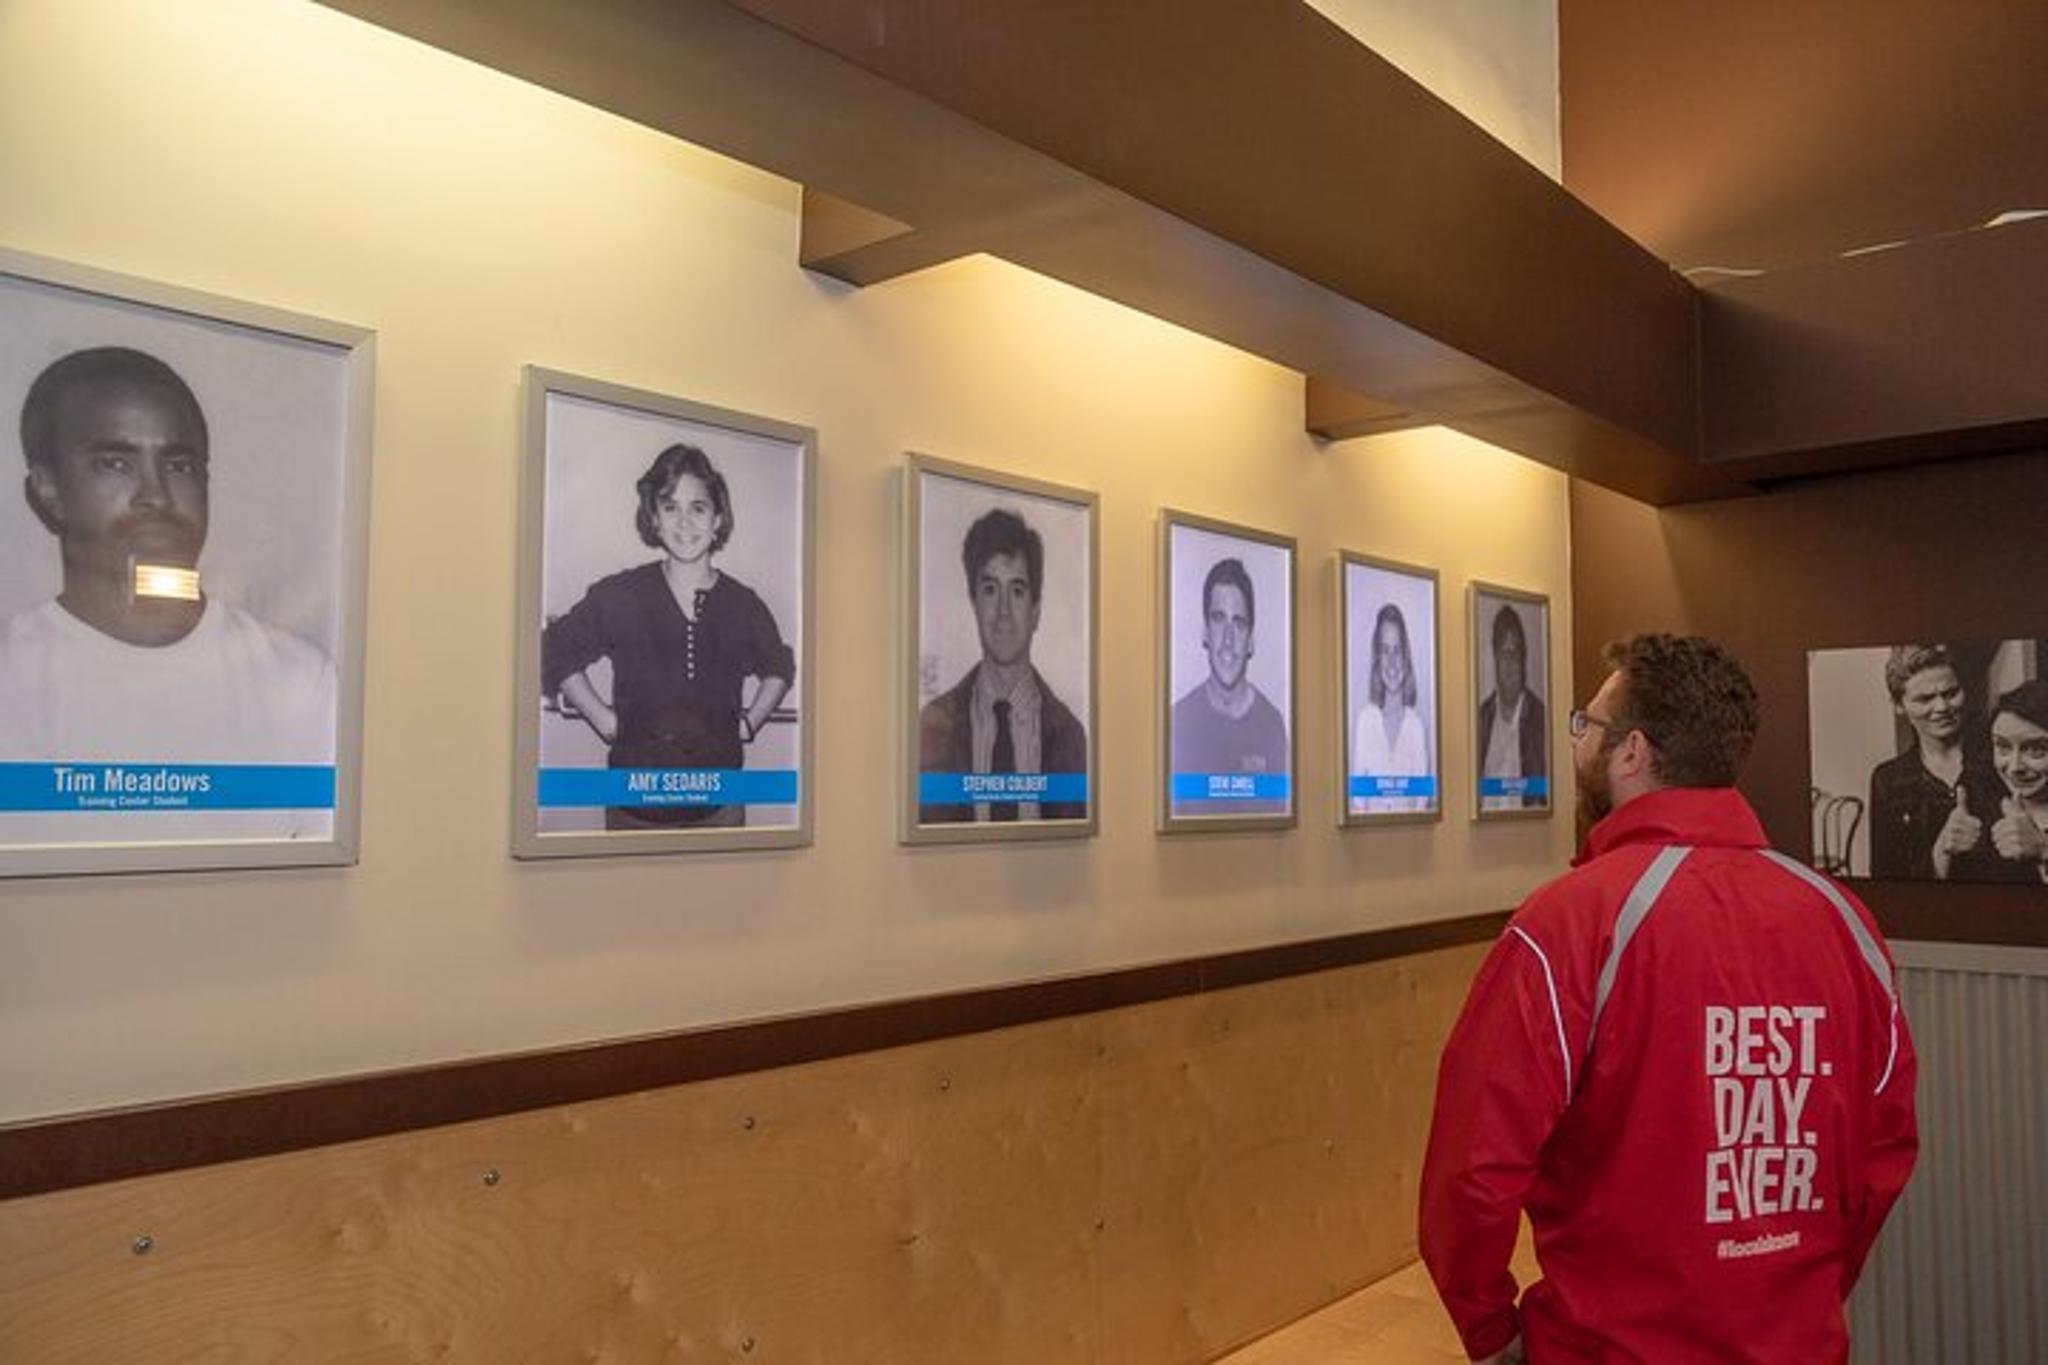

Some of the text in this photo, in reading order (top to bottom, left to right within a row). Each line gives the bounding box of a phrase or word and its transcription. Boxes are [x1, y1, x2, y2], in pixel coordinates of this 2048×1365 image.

[54, 767, 211, 792] Tim Meadows
[628, 773, 658, 791] AMY
[1705, 1006, 1833, 1076] BEST.
[1713, 1077, 1818, 1147] DAY.
[1705, 1147, 1824, 1223] EVER.
